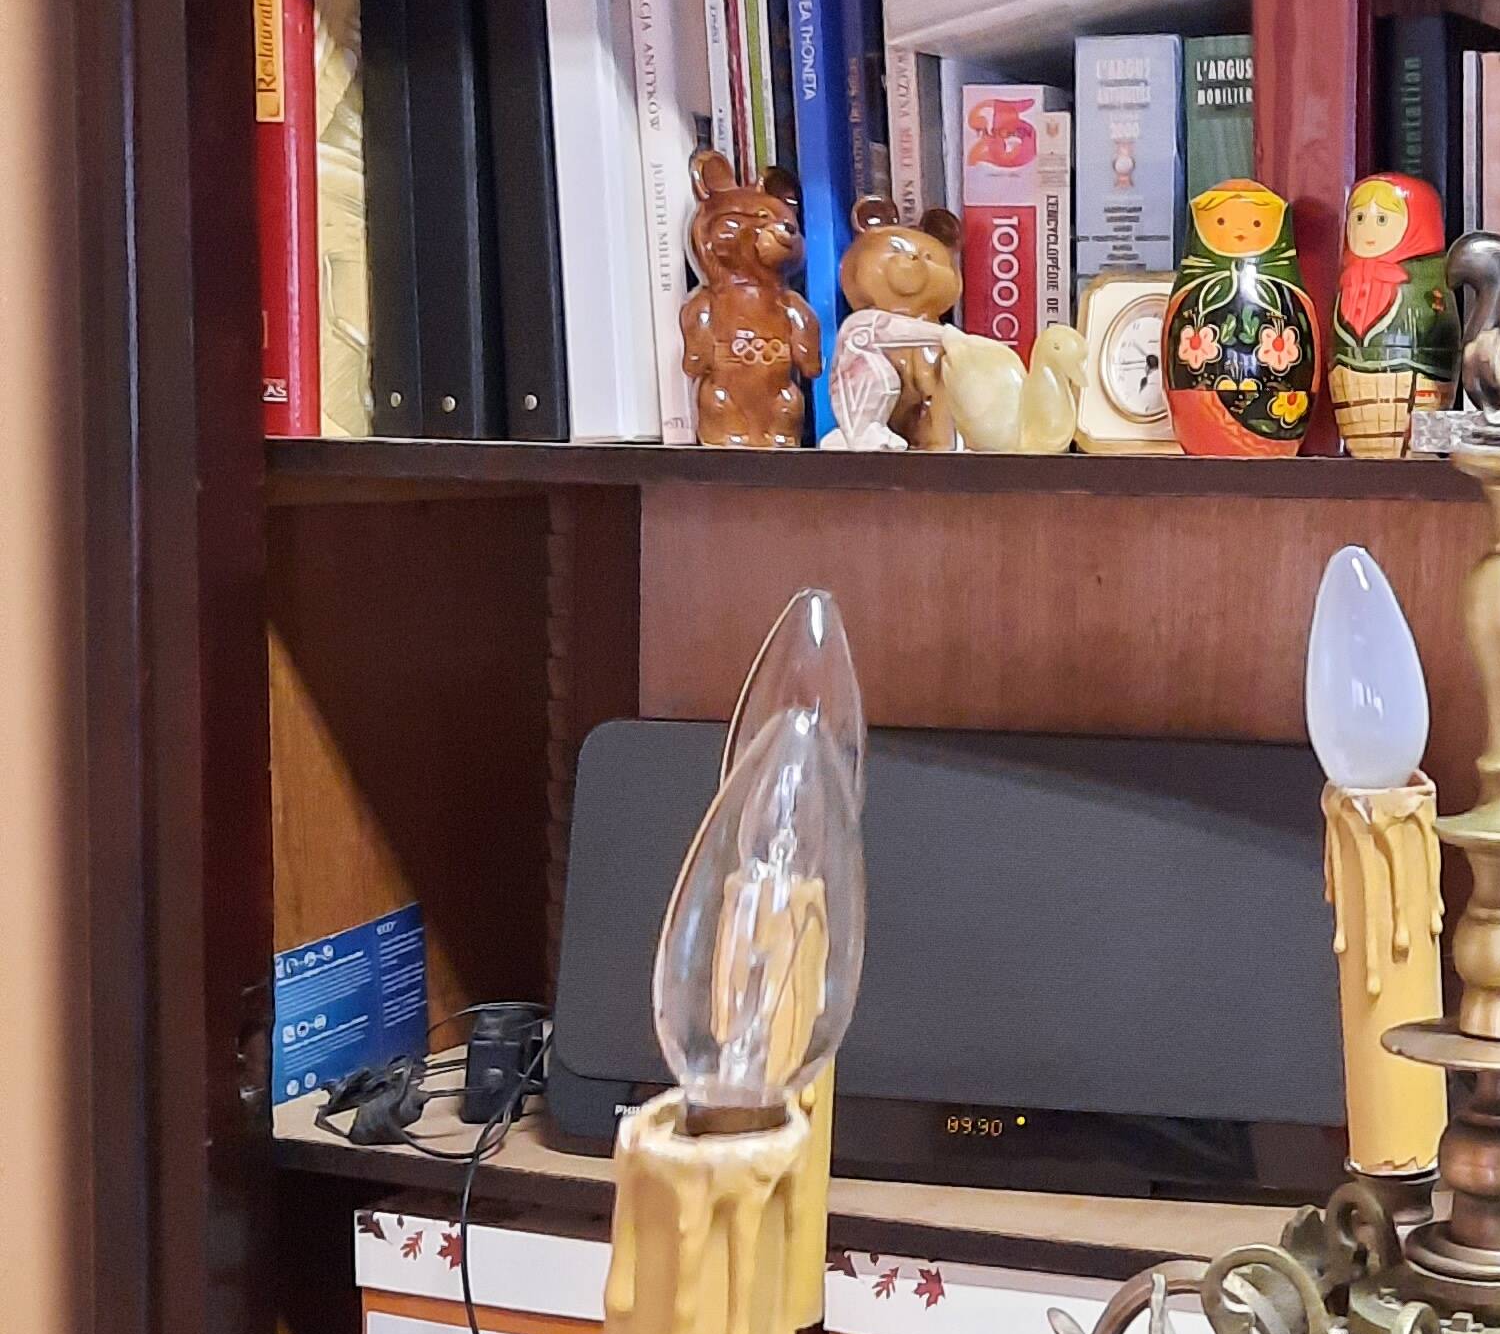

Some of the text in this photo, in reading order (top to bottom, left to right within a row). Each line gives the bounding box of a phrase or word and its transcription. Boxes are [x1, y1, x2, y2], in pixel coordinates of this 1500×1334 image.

[801, 21, 818, 101] THONETA
[1196, 58, 1253, 81] L'ARGUS
[652, 163, 673, 293] JUDITH MILLER
[902, 178, 916, 224] NAPRA
[991, 216, 1020, 309] 1000
